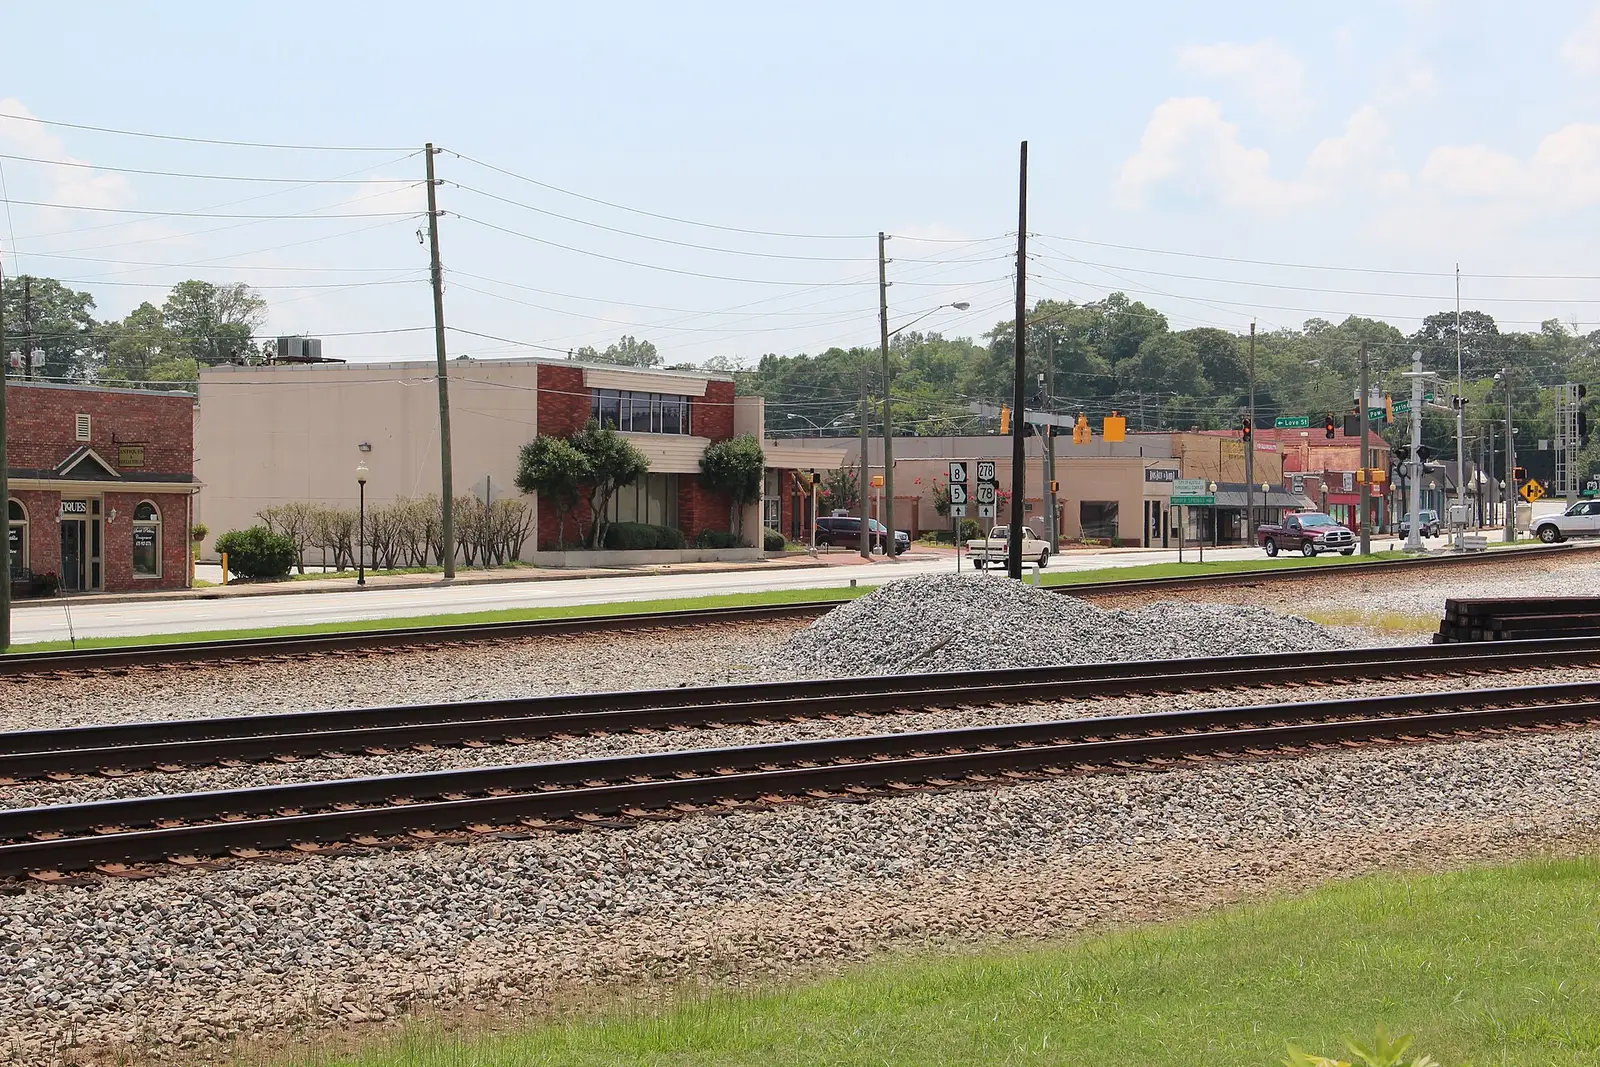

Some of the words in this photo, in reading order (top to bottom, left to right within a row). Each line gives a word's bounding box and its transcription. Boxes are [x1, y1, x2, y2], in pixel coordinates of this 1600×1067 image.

[954, 469, 960, 479] 8
[979, 465, 993, 476] 278
[954, 488, 960, 499] 5
[980, 487, 993, 499] 78
